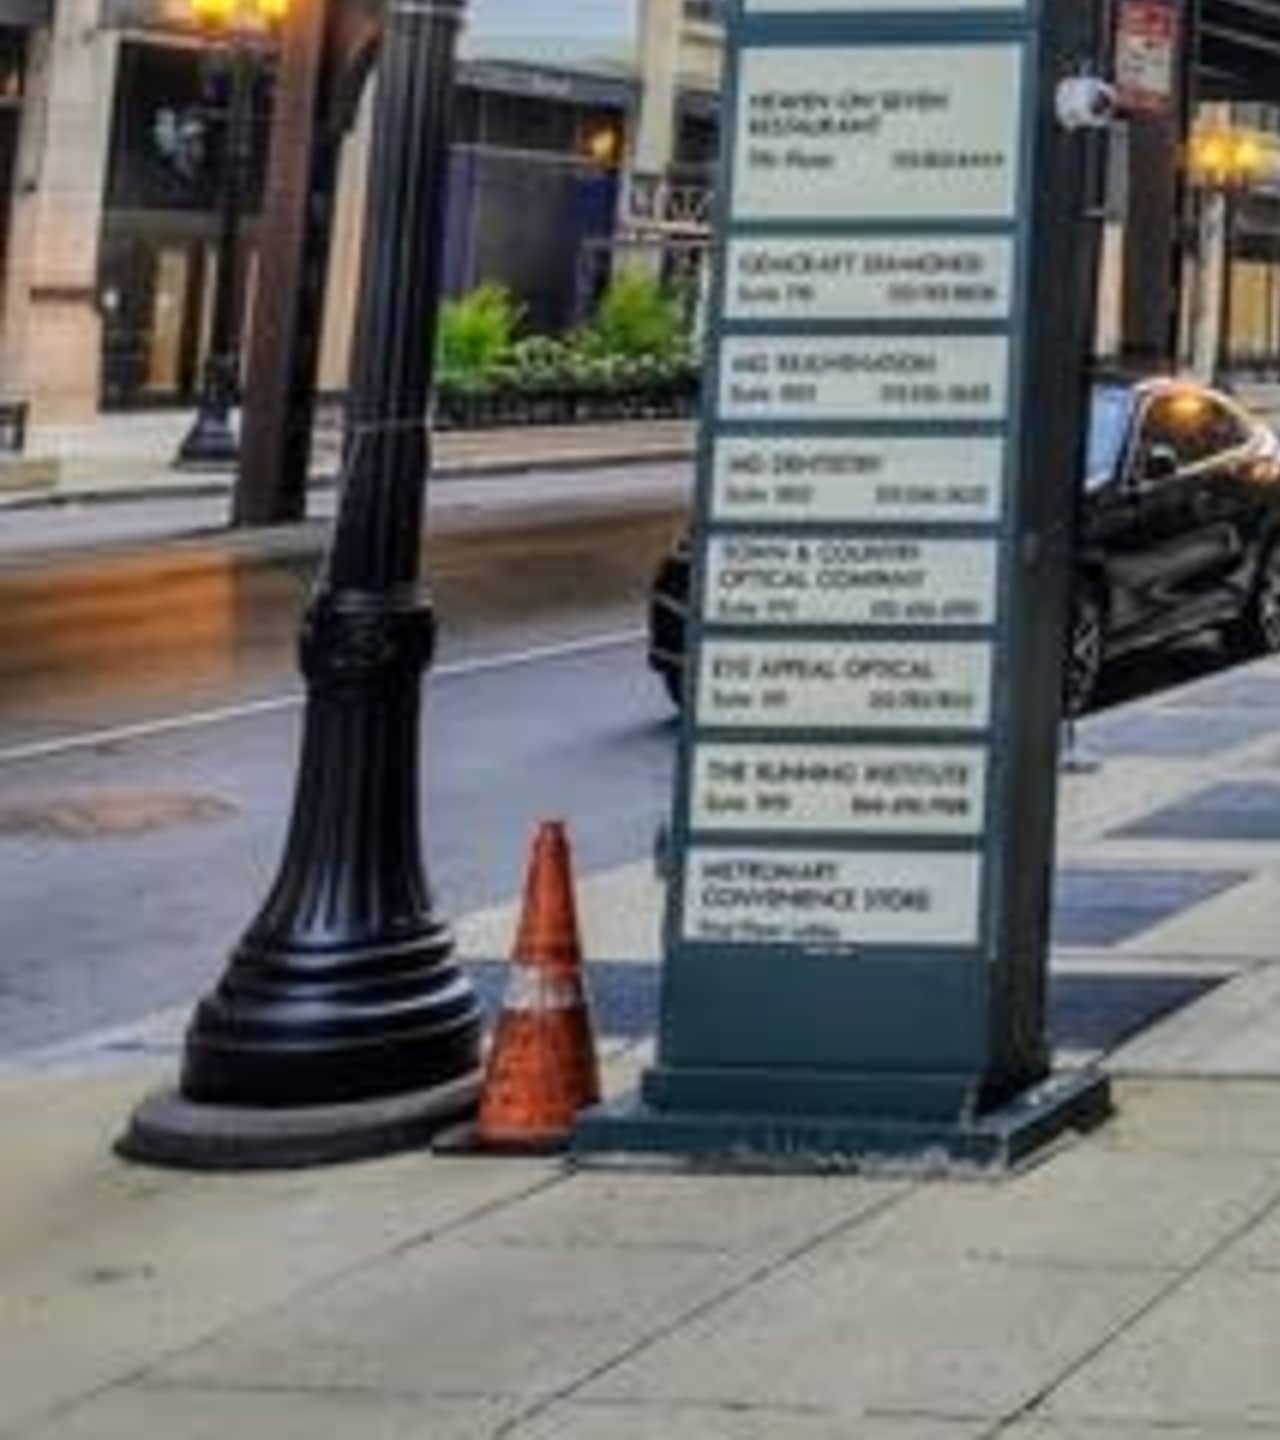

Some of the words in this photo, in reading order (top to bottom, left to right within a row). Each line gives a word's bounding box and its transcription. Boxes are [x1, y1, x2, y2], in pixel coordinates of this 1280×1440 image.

[719, 569, 808, 589] OPTICAL
[757, 660, 836, 680] APPEAL
[843, 660, 934, 680] OPTICAL
[706, 761, 745, 782] THE
[754, 762, 858, 783] RUNNING
[701, 888, 856, 911] CONVENIENCE
